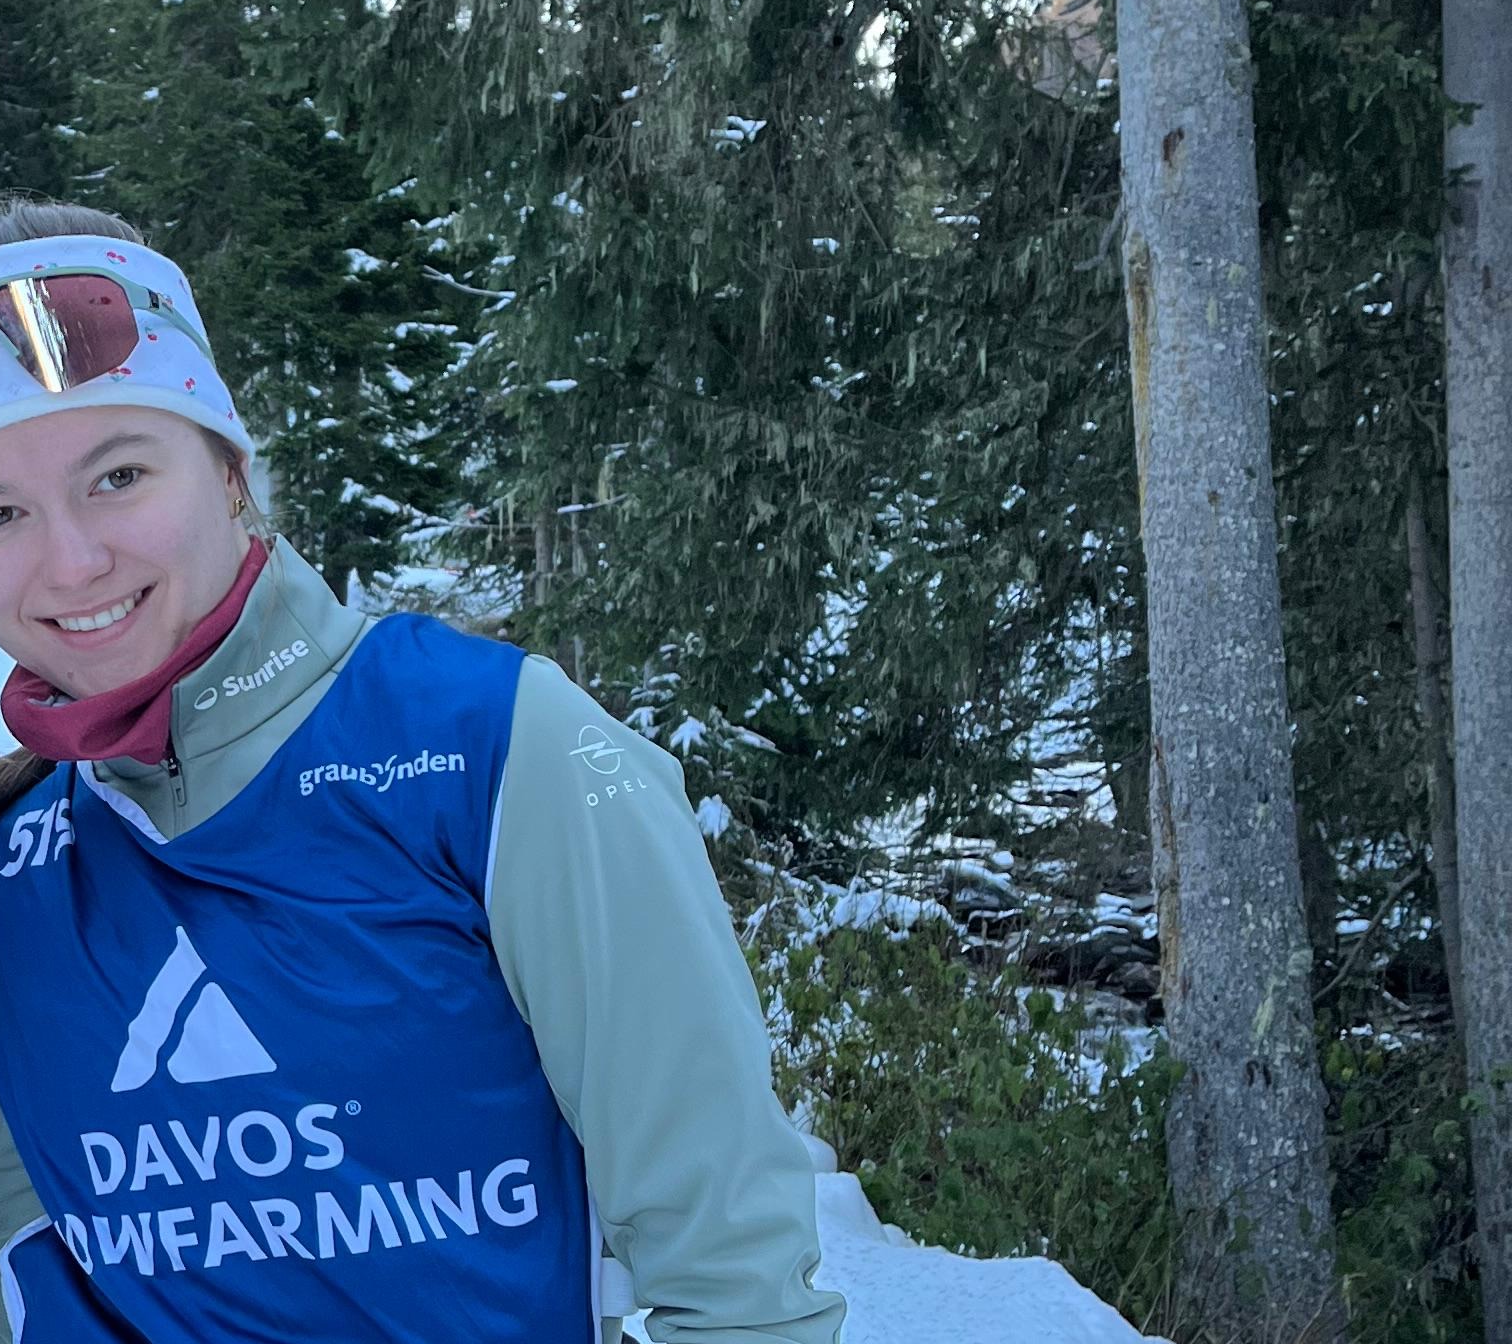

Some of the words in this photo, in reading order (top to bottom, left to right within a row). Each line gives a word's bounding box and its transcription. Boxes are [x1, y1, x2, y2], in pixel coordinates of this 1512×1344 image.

[222, 639, 309, 697] Sunrise
[586, 776, 648, 807] OPEL
[54, 1158, 538, 1277] OWFARMING
